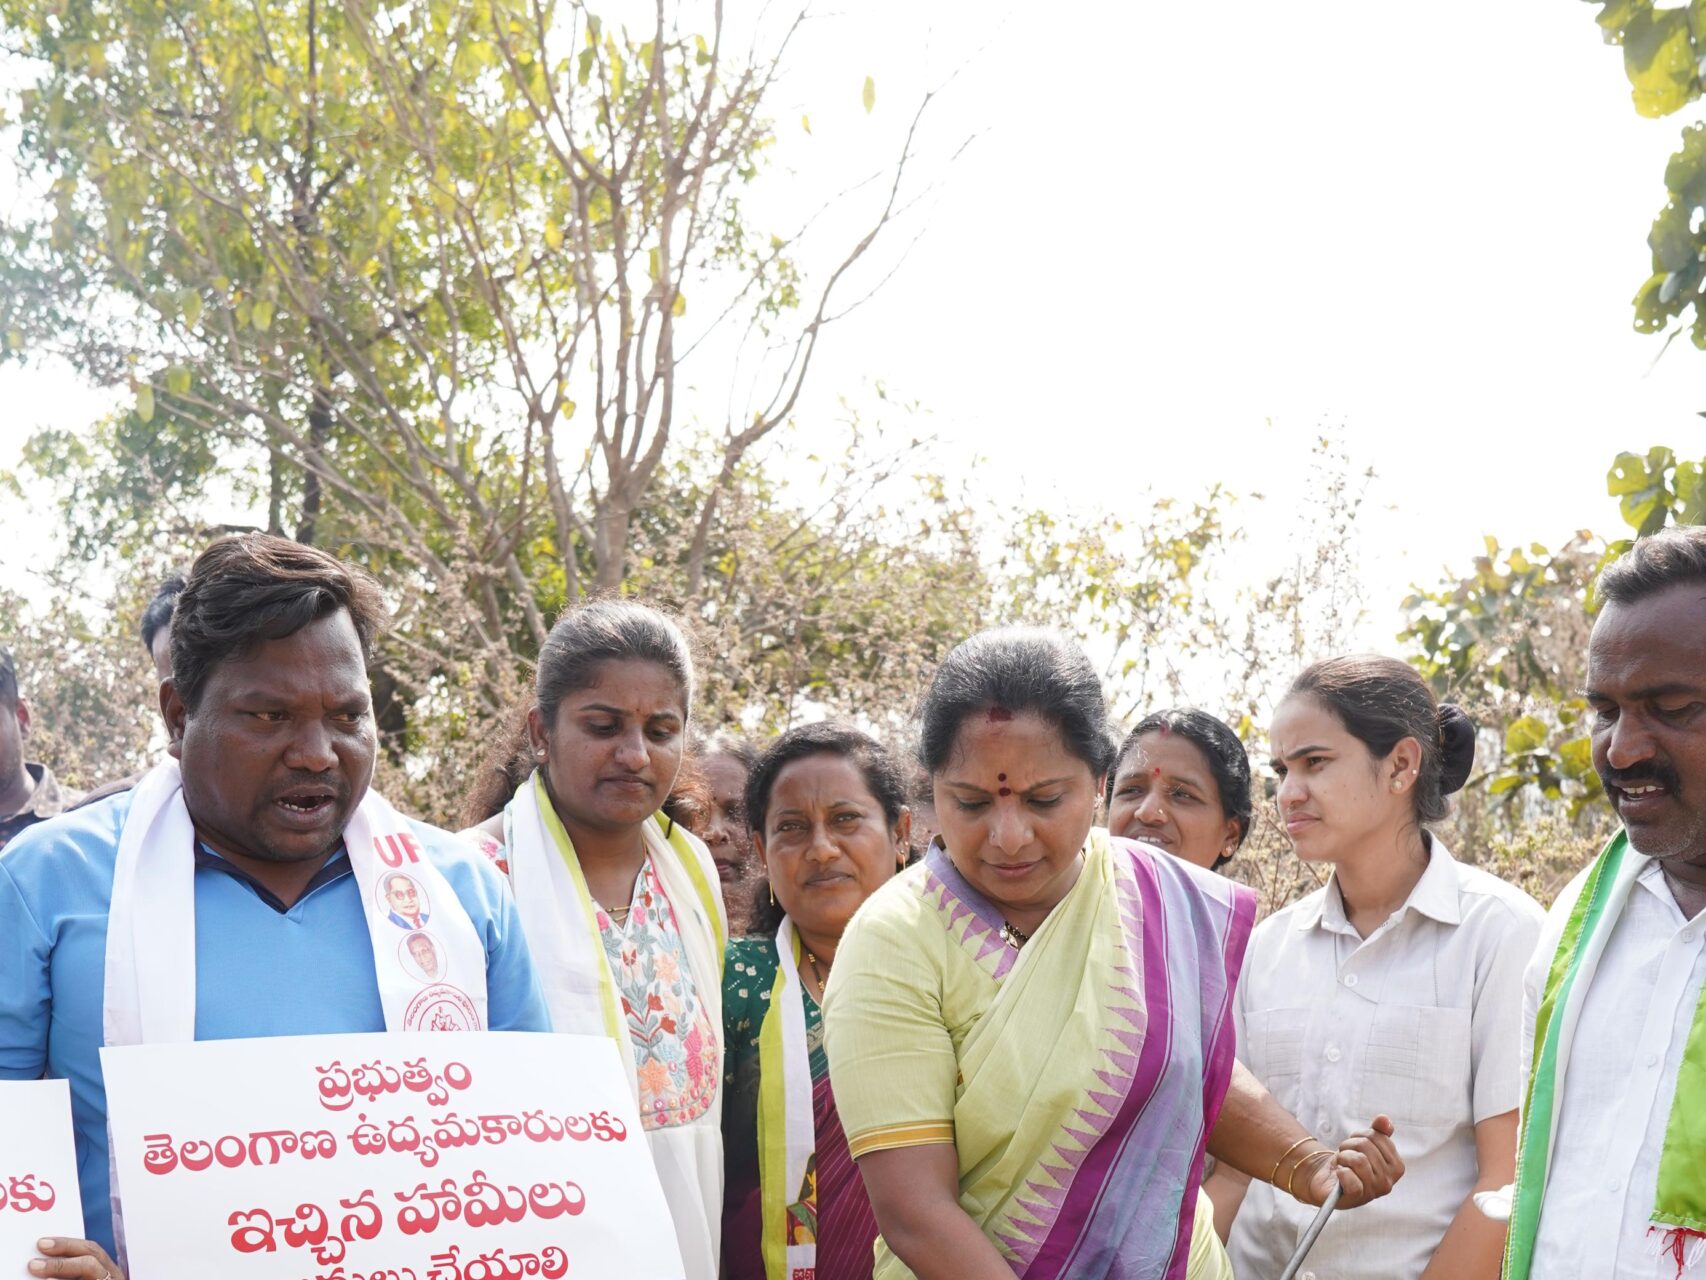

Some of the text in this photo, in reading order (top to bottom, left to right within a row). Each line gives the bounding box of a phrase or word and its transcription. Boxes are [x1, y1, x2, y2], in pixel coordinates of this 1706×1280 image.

[315, 1057, 472, 1112] ప్రభుత్వం
[143, 1109, 627, 1176] తెలంగాణ ఉద్యమకారులకు
[0, 1174, 56, 1213] కు
[228, 1170, 586, 1266] ఇచ్చిన హామీలు
